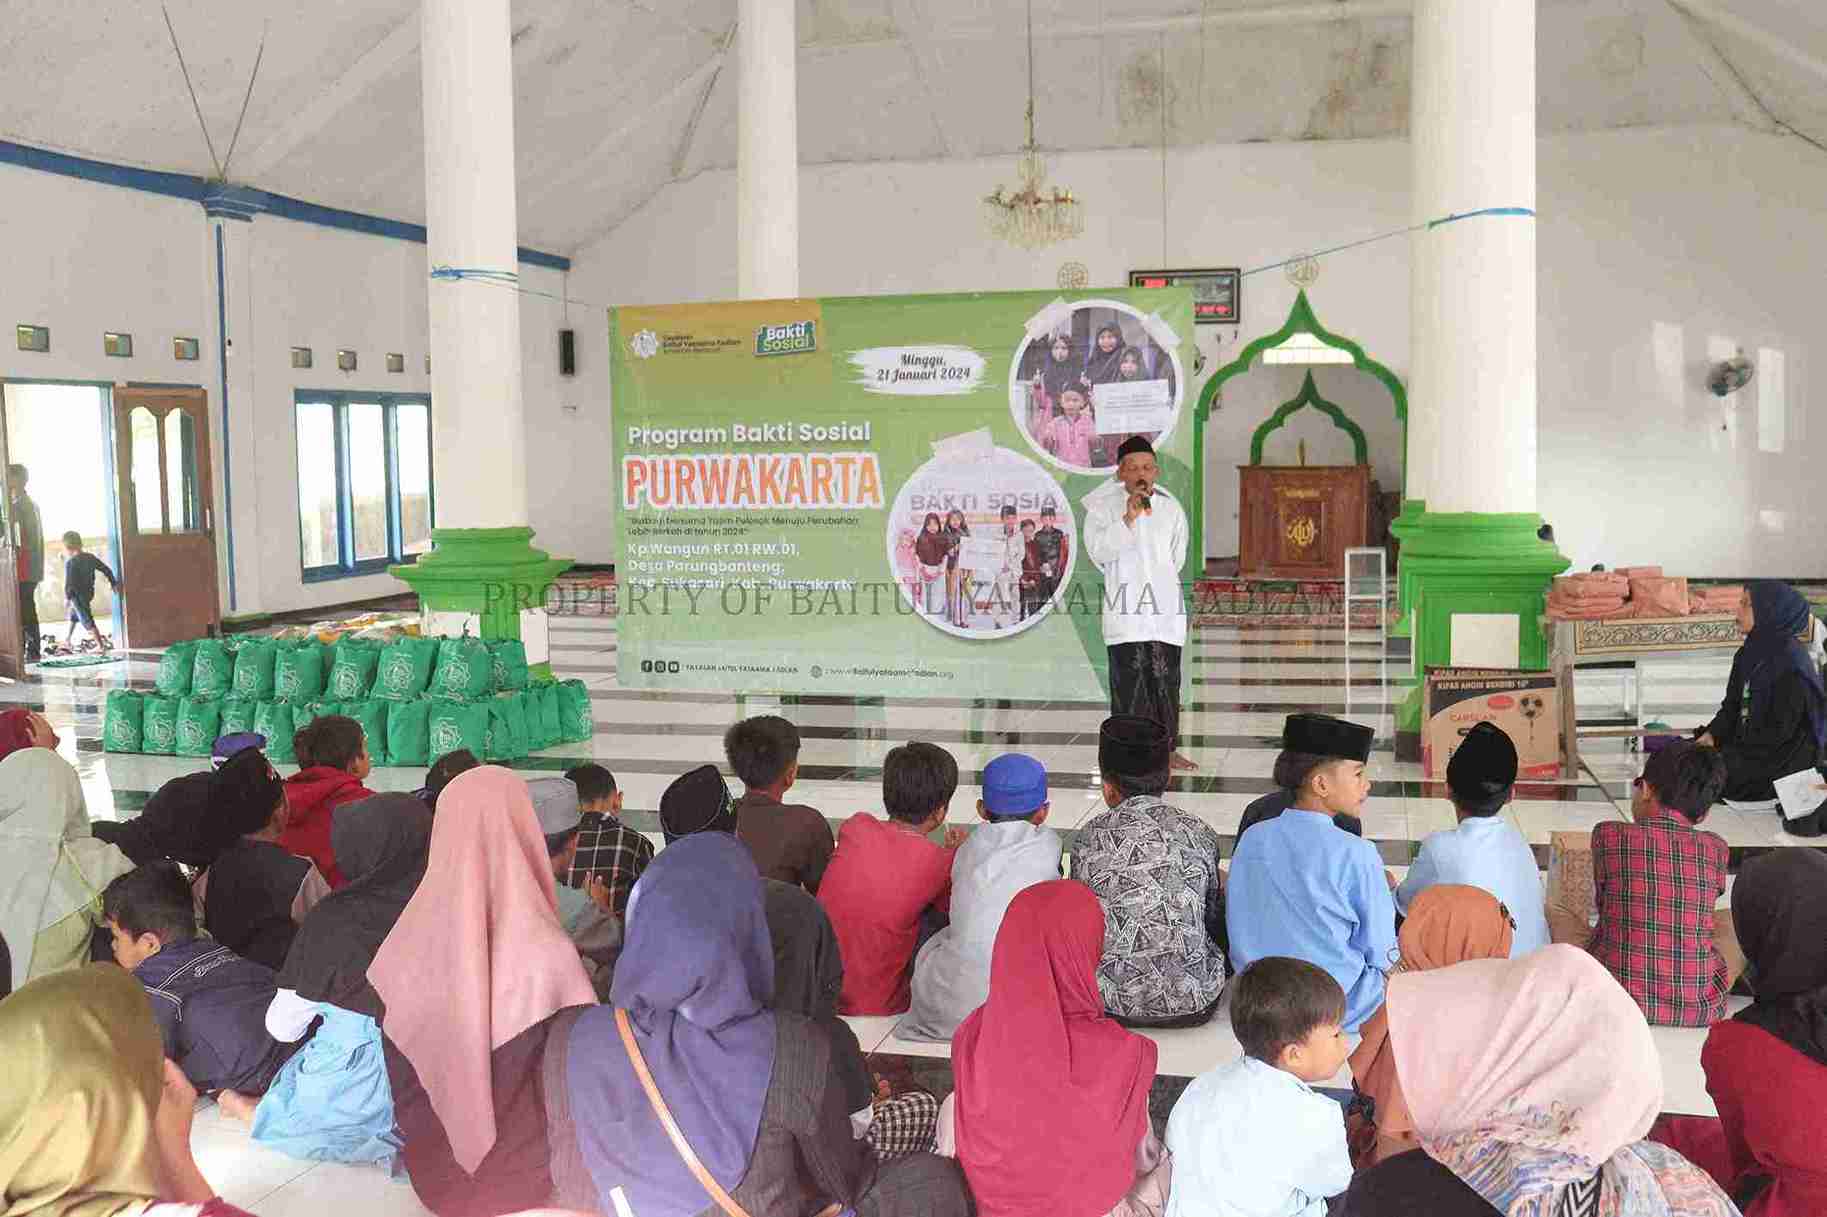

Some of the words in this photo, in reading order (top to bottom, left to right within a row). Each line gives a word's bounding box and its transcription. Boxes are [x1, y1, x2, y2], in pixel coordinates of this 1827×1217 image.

[767, 322, 805, 340] Bakti
[763, 336, 809, 352] Sosial
[901, 353, 946, 368] Minggu,
[877, 368, 889, 381] 21
[891, 368, 936, 383] Januari
[940, 367, 970, 380] 2024
[628, 427, 727, 449] Program
[732, 423, 793, 442] Bakti
[799, 421, 871, 441] Sosial
[625, 455, 882, 508] PURWAKARTA
[911, 491, 977, 511] BAKTI
[628, 560, 663, 574] Desa
